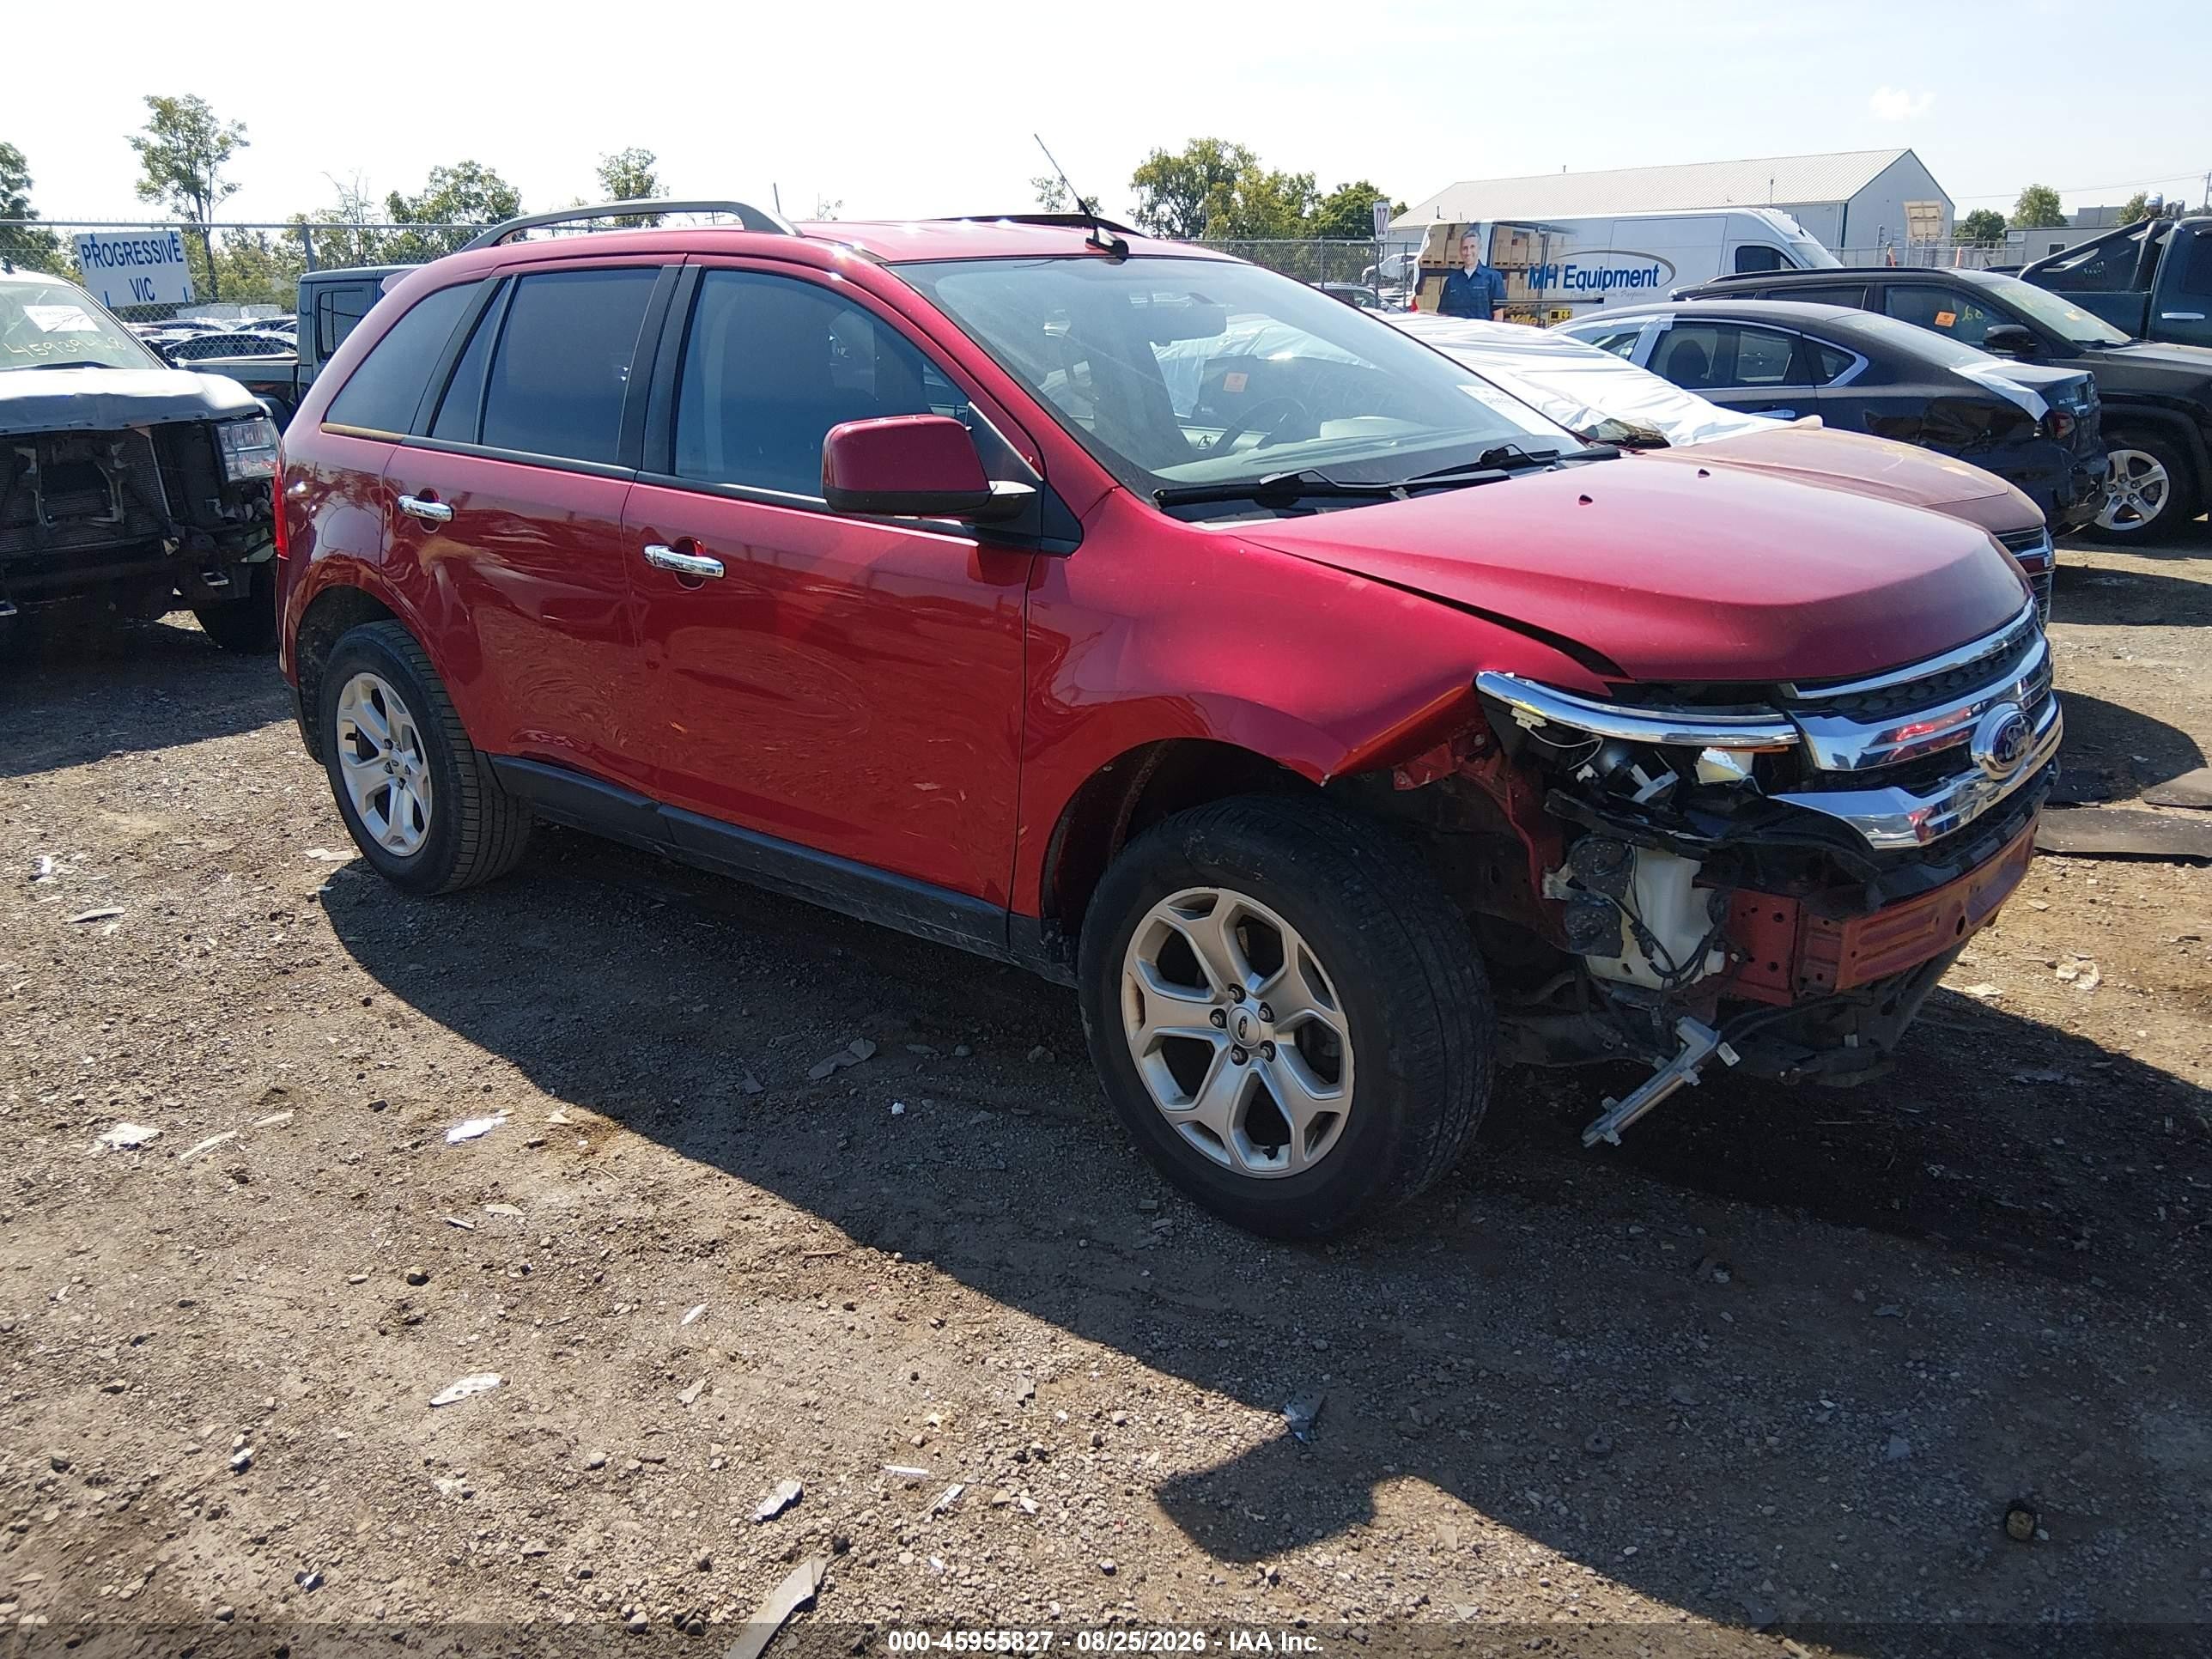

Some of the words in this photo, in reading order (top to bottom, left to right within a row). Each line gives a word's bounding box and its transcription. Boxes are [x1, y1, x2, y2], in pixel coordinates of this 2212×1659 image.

[81, 238, 184, 269] PROGRESSIVE
[129, 276, 155, 302] VIC
[1528, 264, 1559, 290] MH
[1563, 263, 1660, 292] Equipment
